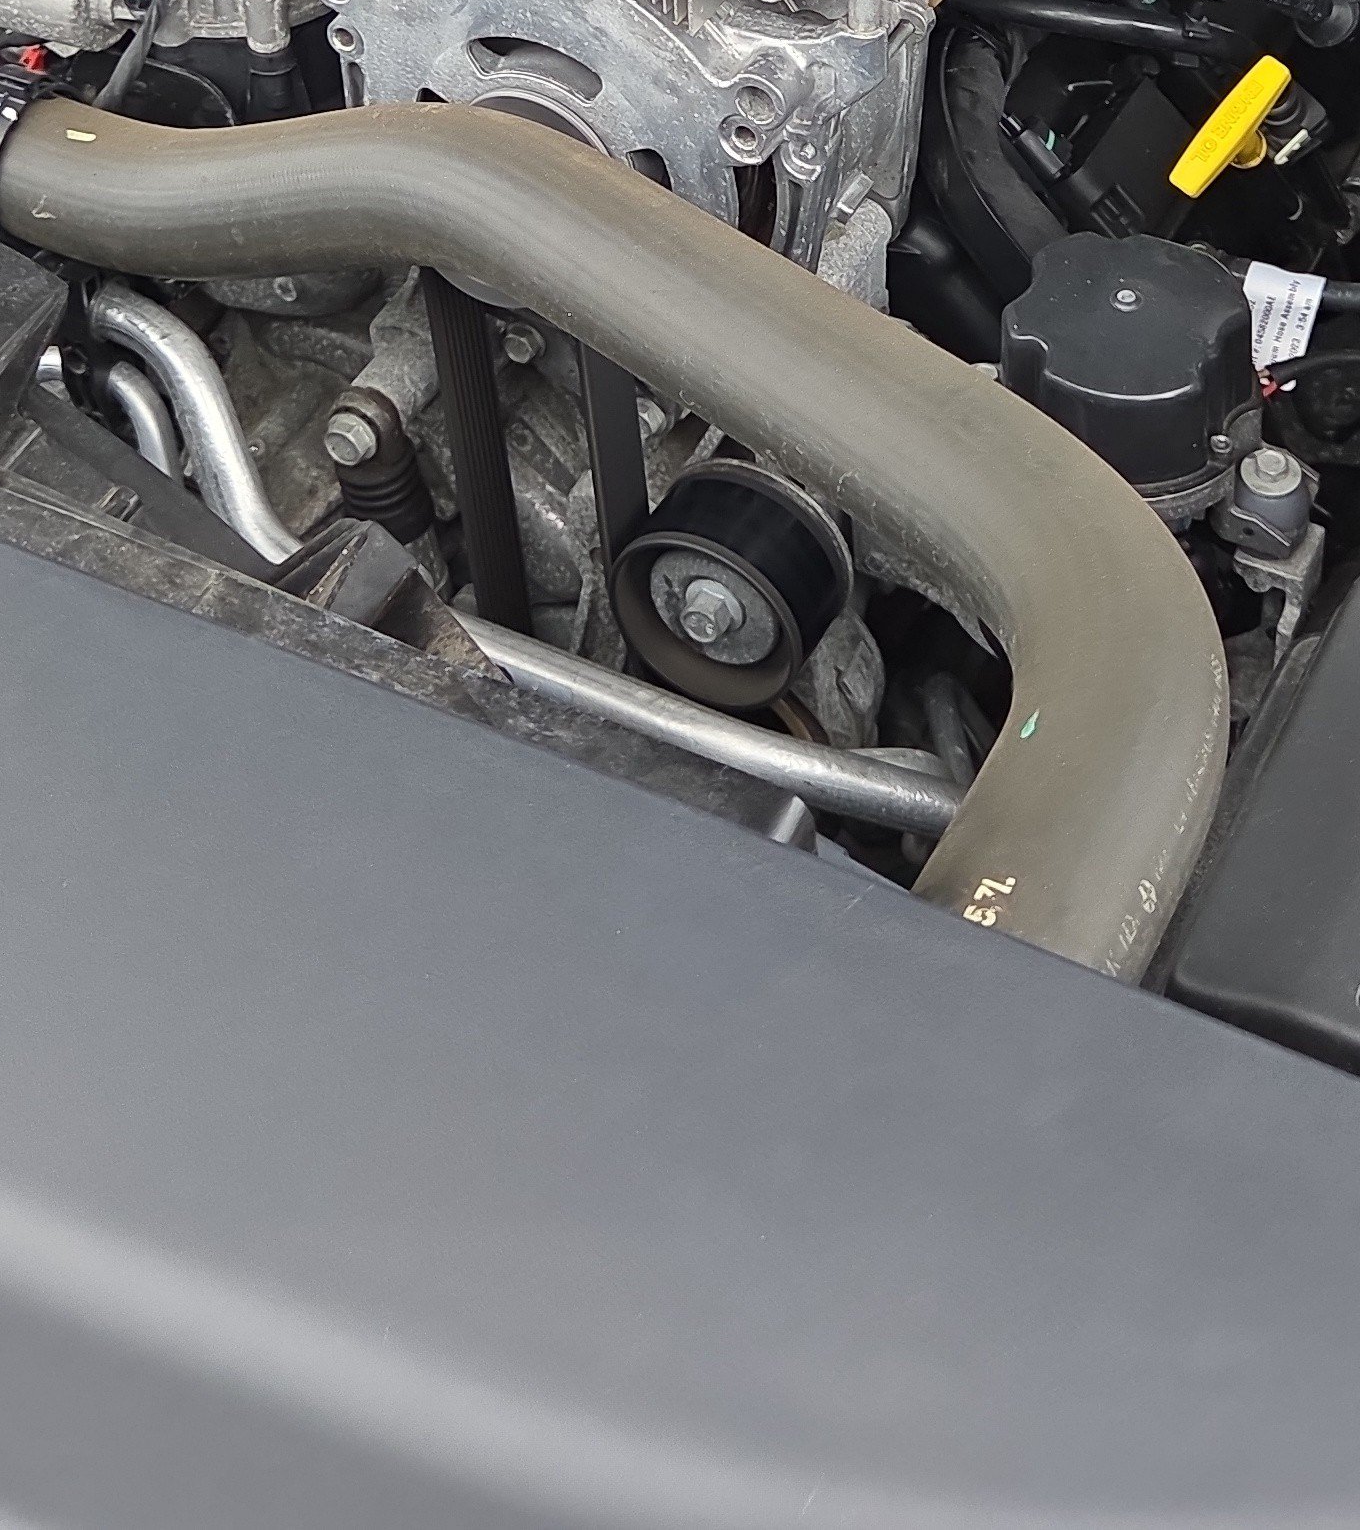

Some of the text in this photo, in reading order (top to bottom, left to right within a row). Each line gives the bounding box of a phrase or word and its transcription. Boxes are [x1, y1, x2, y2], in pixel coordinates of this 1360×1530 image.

[1190, 79, 1265, 163] ENGINE OIL
[1280, 279, 1302, 321] Assembly
